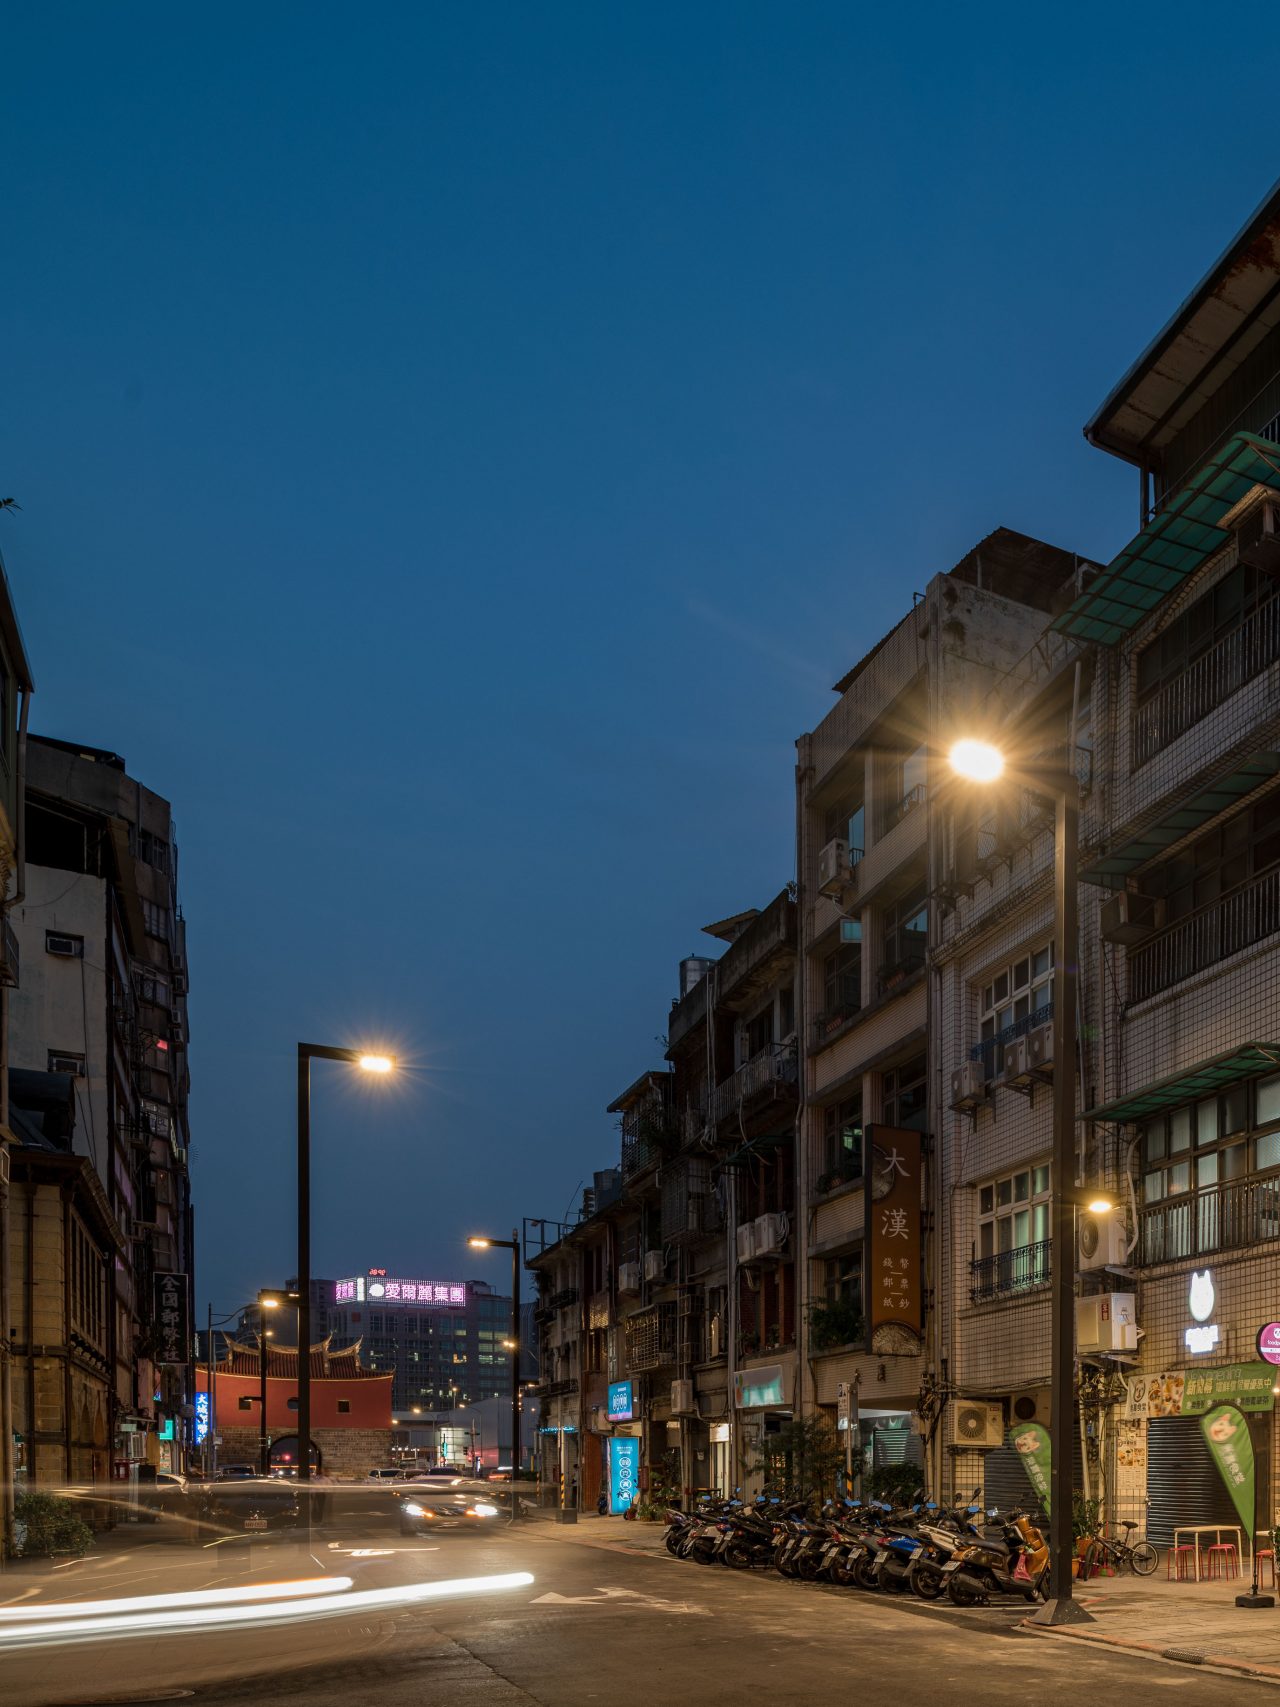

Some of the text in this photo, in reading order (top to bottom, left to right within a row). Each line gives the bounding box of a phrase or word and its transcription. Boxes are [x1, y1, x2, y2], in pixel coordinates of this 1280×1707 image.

[880, 1146, 912, 1240] 大漢
[385, 1283, 464, 1303] 愛爾麗集團
